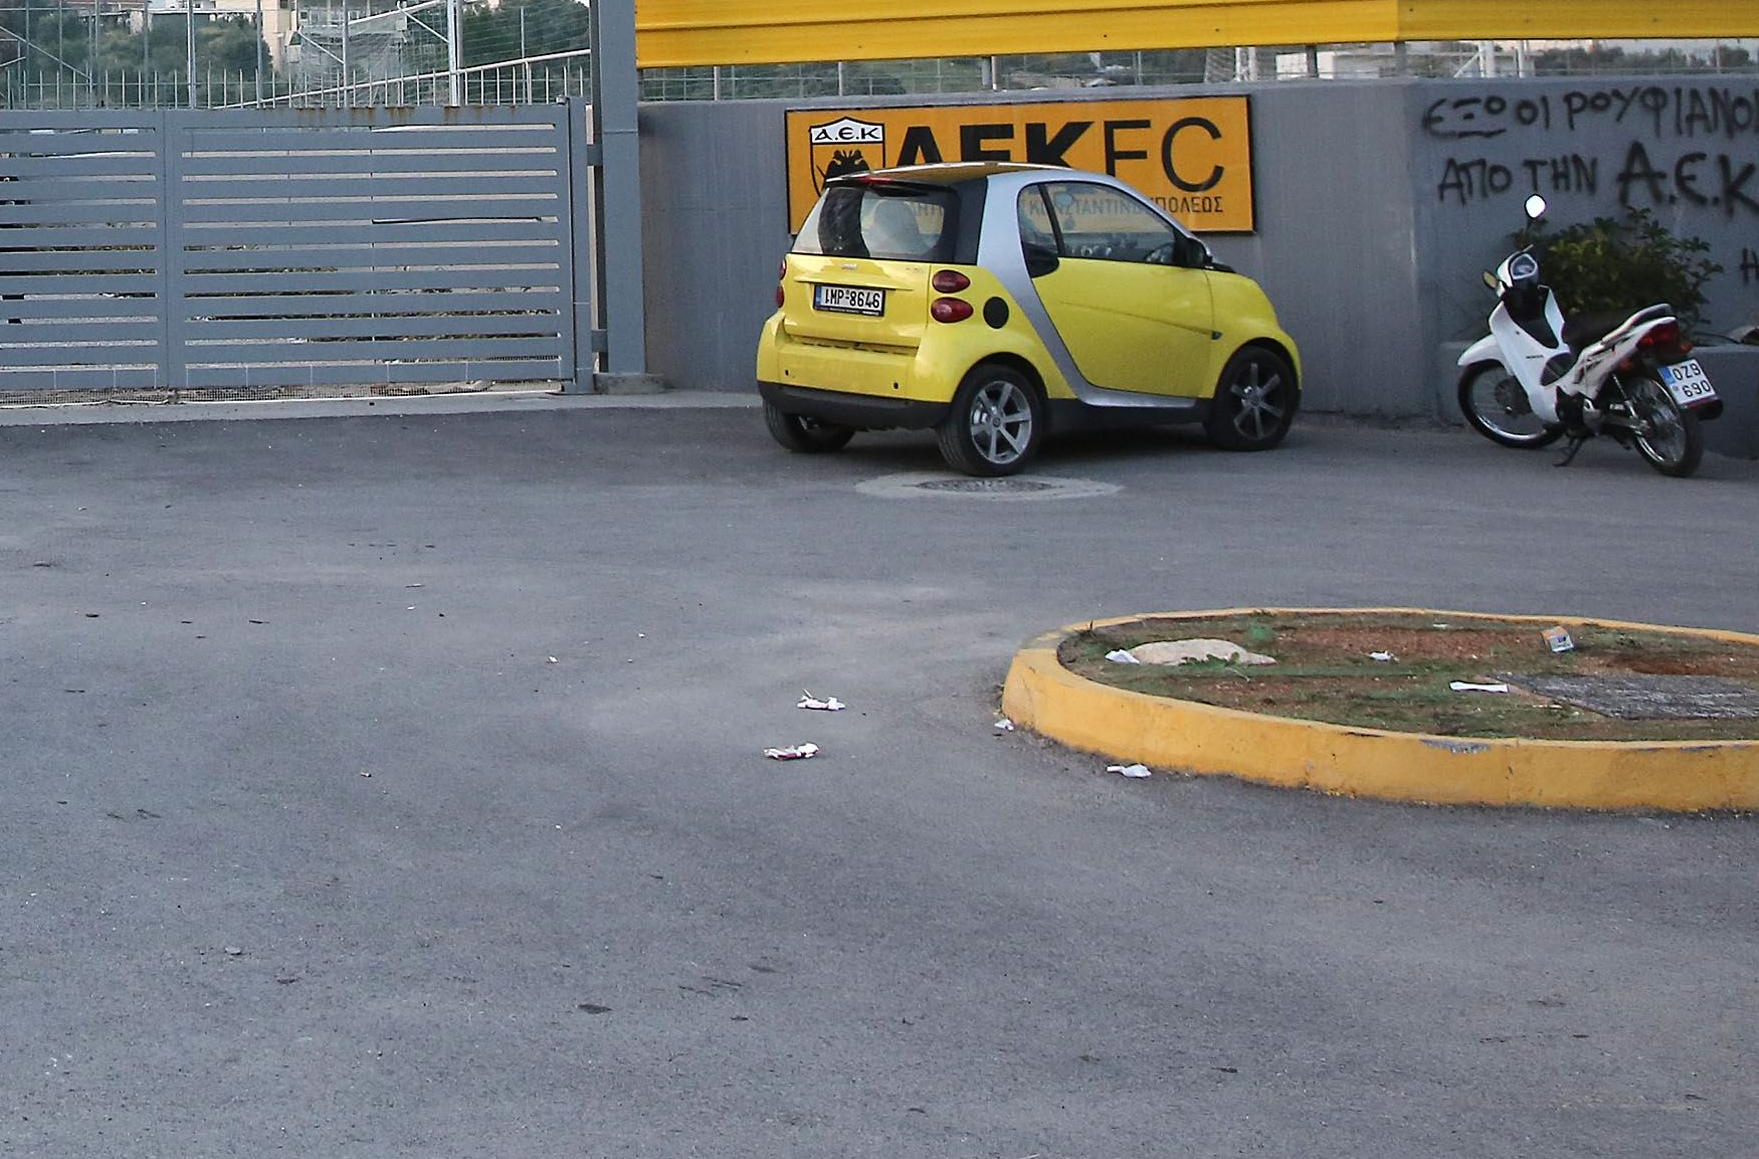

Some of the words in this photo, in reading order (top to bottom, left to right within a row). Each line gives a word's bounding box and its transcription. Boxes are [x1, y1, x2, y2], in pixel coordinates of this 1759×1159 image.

[1438, 158, 1512, 206] ΑΠΟ
[1523, 153, 1598, 194] ΤΗΝ
[1683, 380, 1711, 397] 690
